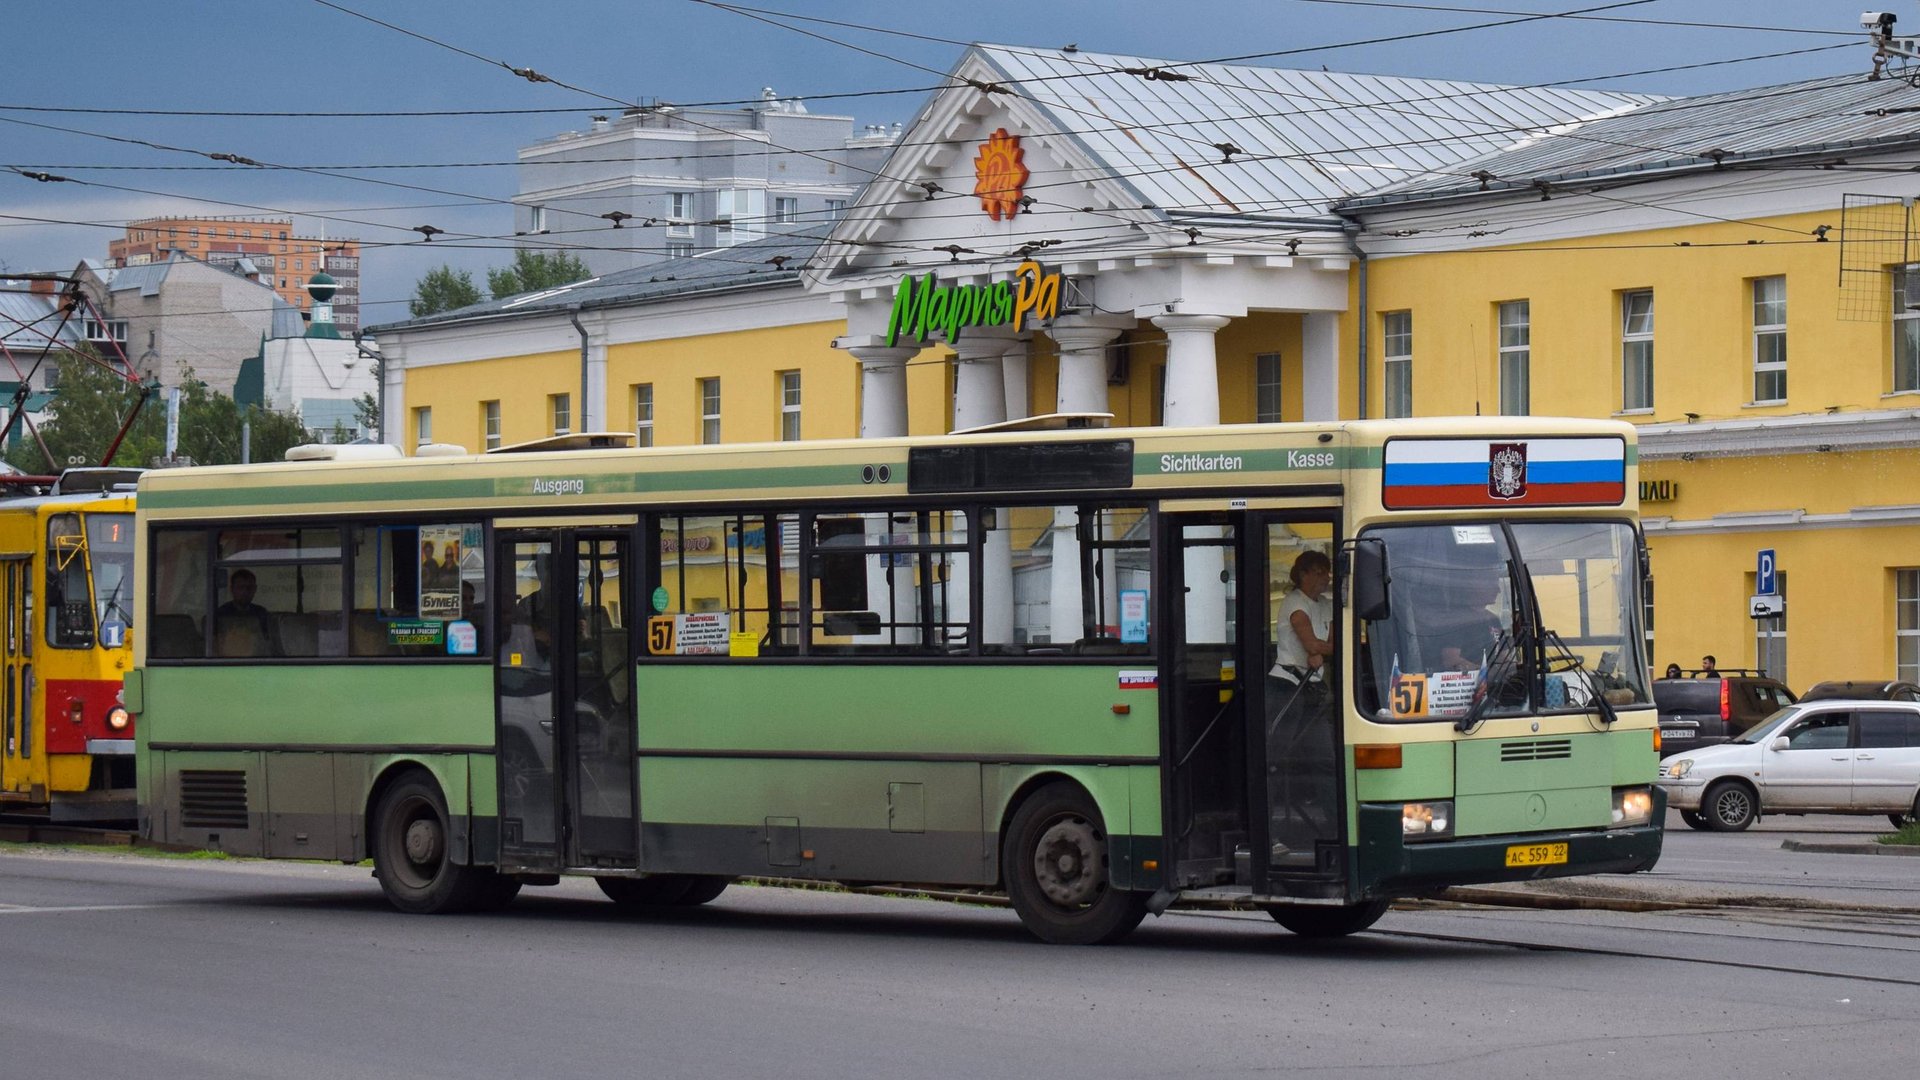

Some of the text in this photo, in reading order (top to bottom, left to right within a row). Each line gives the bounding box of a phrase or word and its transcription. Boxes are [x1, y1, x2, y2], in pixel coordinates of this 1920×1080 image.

[1160, 454, 1243, 473] Sichtkarten
[1287, 450, 1335, 468] Kasse
[533, 478, 584, 496] Ausgang
[112, 523, 119, 542] 1
[1761, 554, 1773, 591] P
[107, 625, 122, 646] 1
[652, 620, 674, 651] 57
[1394, 680, 1424, 715] 57
[1511, 845, 1564, 863] АС 559 22
